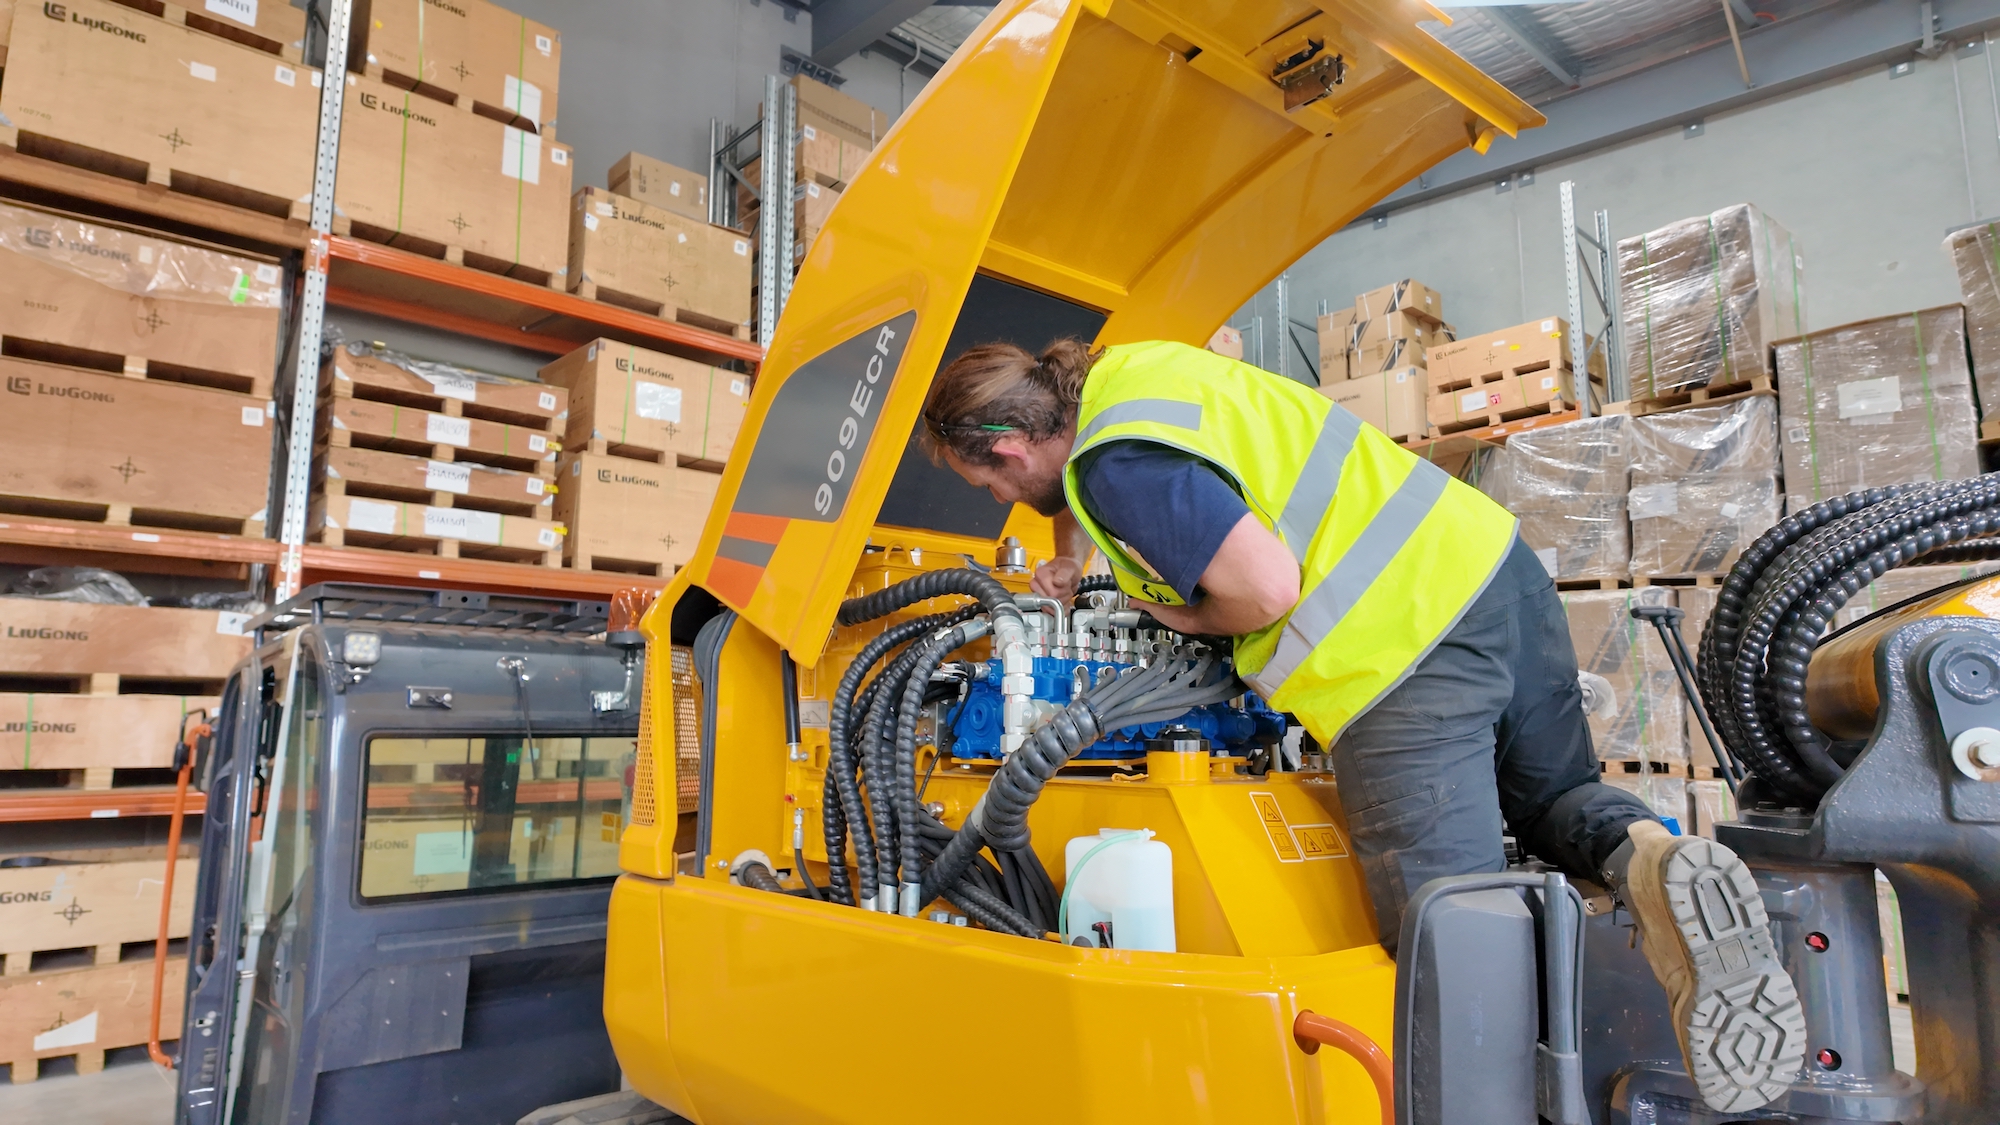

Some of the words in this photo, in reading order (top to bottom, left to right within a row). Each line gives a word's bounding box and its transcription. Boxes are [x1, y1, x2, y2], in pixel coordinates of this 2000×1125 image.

[72, 12, 147, 44] LIUGONG
[381, 101, 436, 127] LIUGONG
[622, 211, 665, 230] LIUGONG
[631, 363, 675, 381] LIUGONG
[37, 382, 116, 404] LIUGONG
[814, 325, 896, 516] 909ECR
[614, 473, 660, 489] LIUGONG
[7, 625, 90, 642] LIUGONG
[0, 889, 52, 905] GONG
